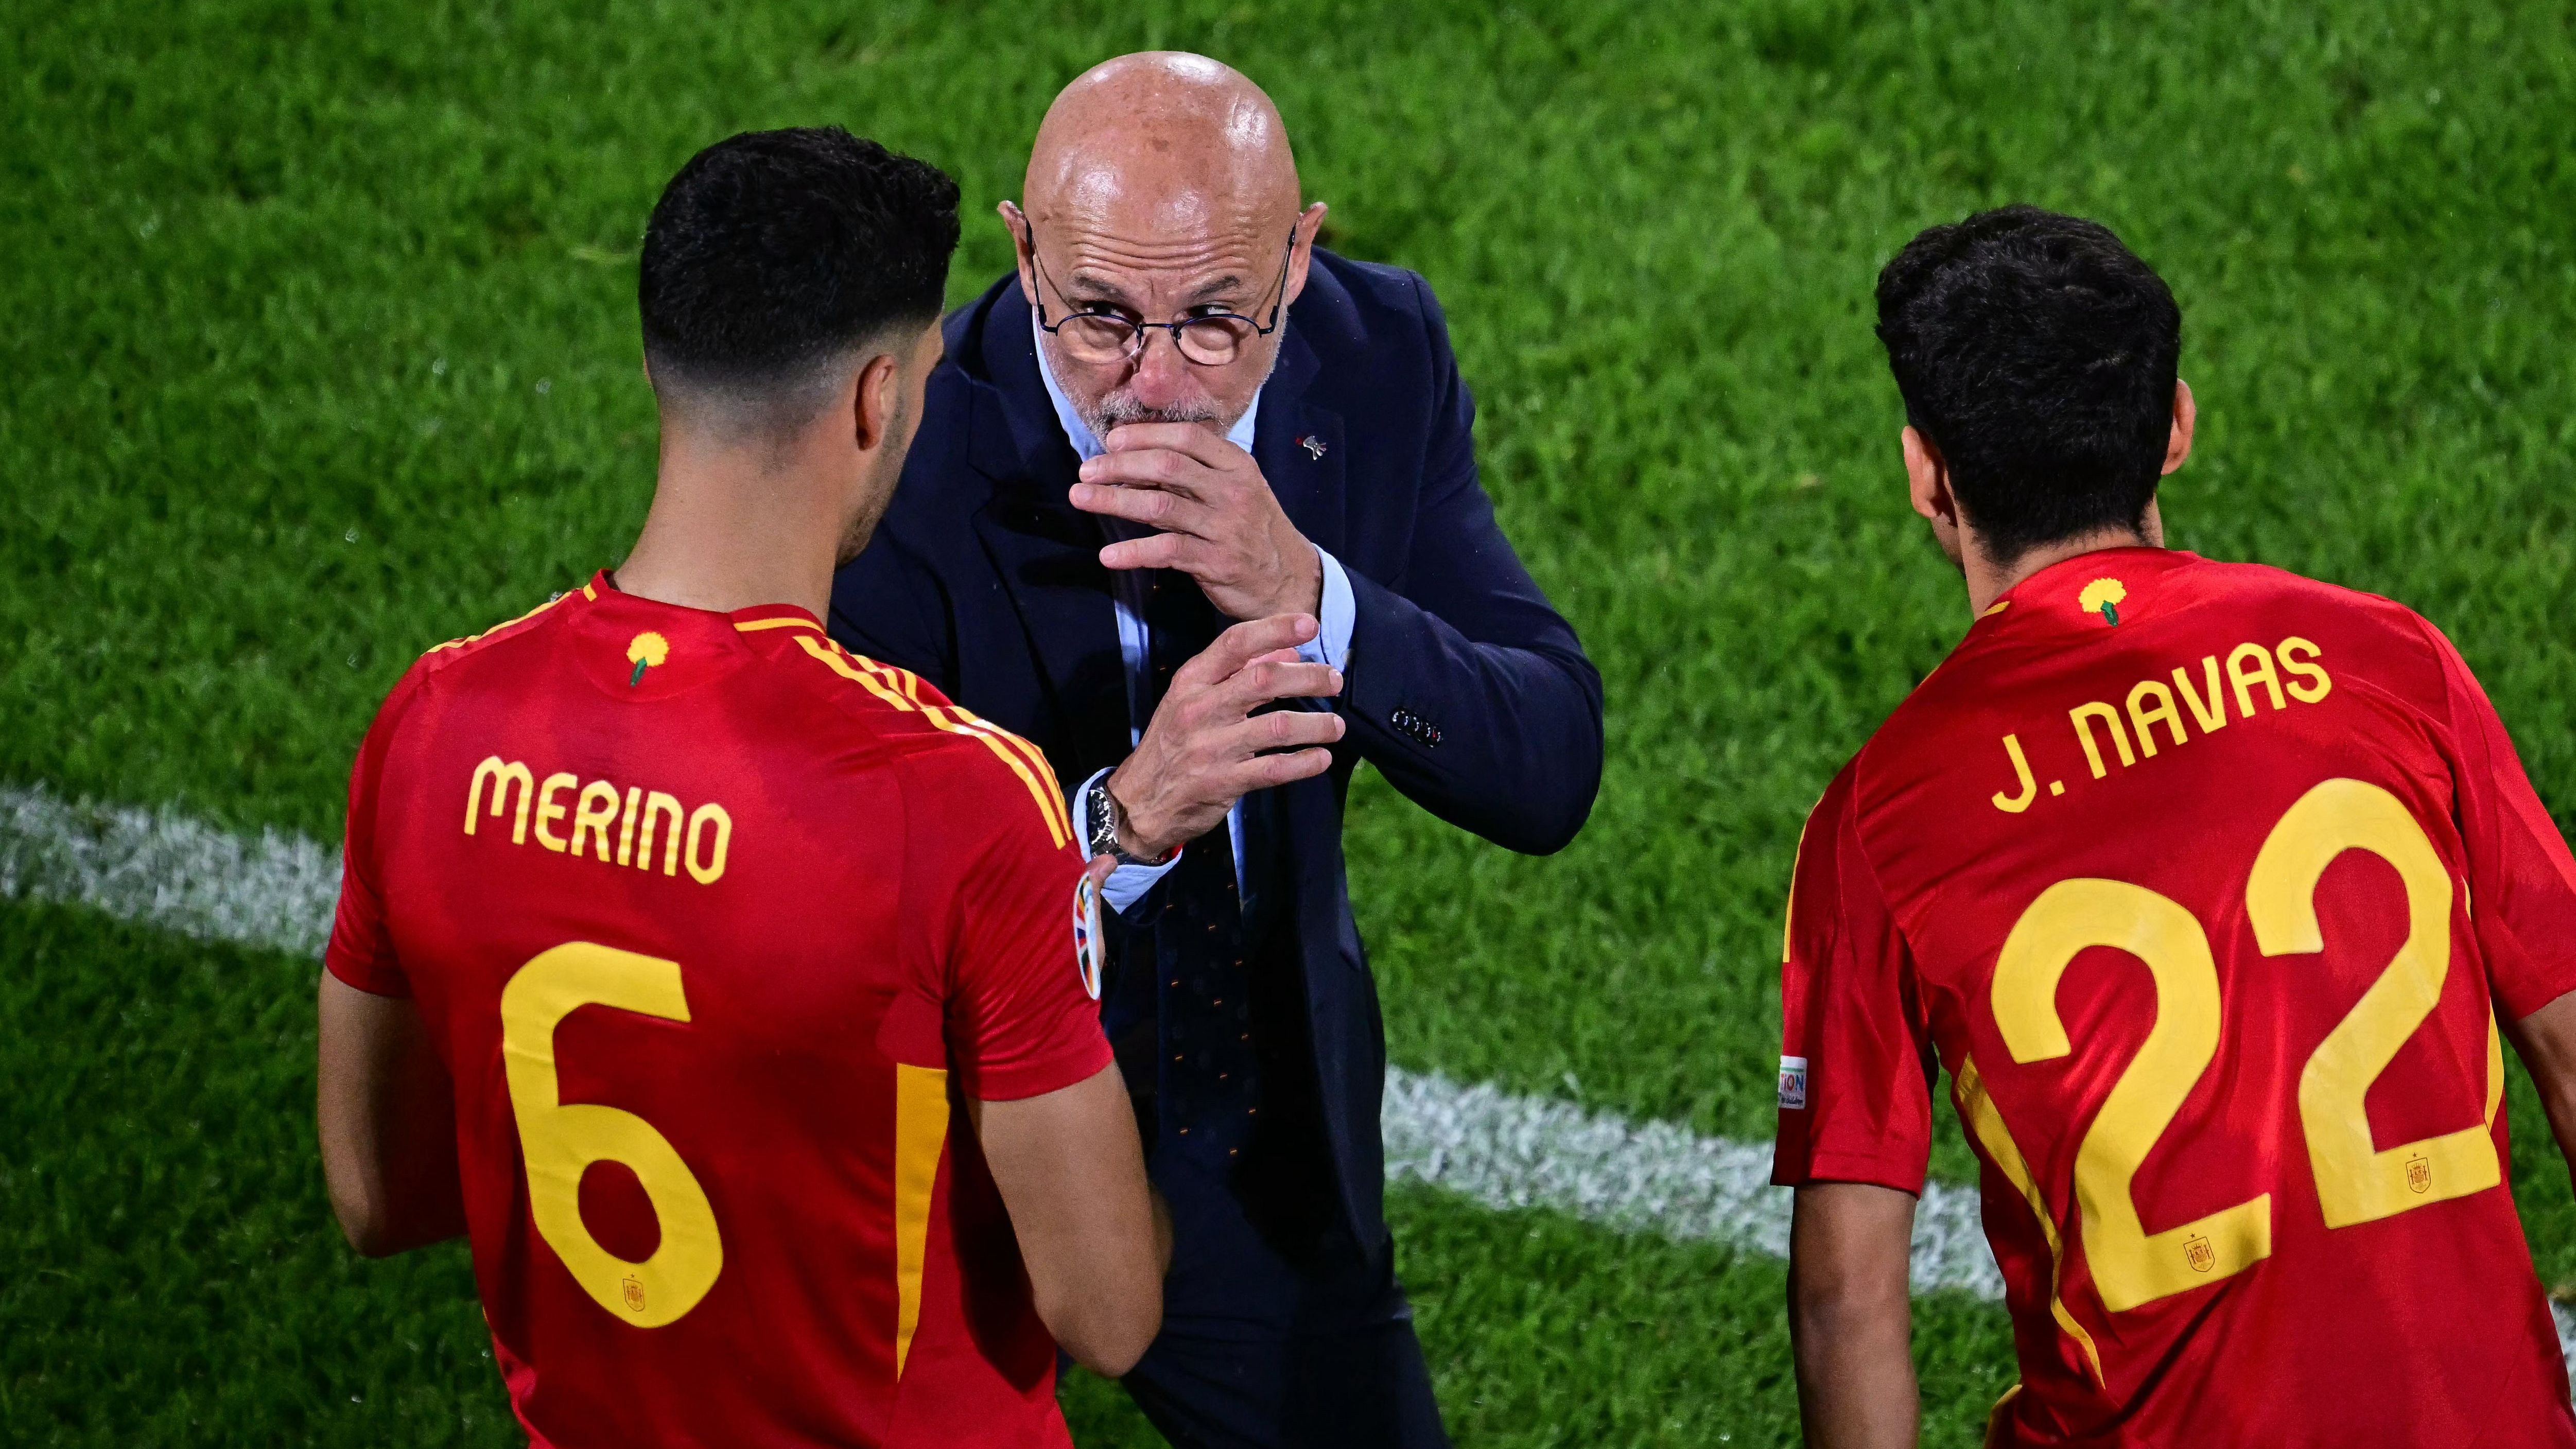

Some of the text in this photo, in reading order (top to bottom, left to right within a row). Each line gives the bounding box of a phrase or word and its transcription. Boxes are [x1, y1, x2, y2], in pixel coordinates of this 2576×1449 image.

[464, 756, 732, 884] MERINO
[1992, 636, 2331, 812] J. NAVAS
[500, 942, 723, 1328] 6
[1991, 778, 2501, 1312] 22
